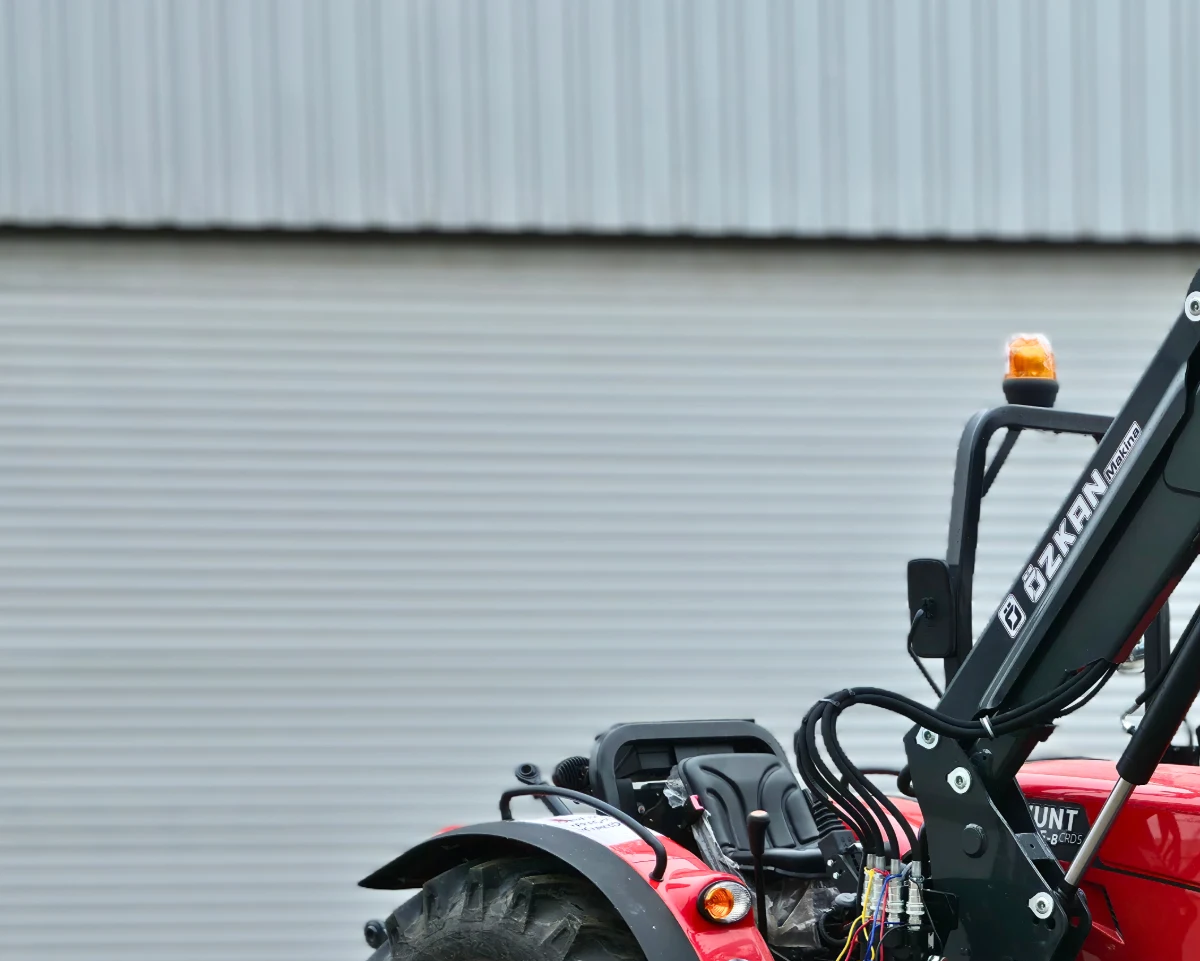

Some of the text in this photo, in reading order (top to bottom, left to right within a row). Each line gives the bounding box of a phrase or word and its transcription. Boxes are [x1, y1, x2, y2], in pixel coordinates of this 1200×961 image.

[1022, 468, 1110, 603] ÖZKAN
[1104, 421, 1141, 482] Makina
[1029, 805, 1078, 831] UNT
